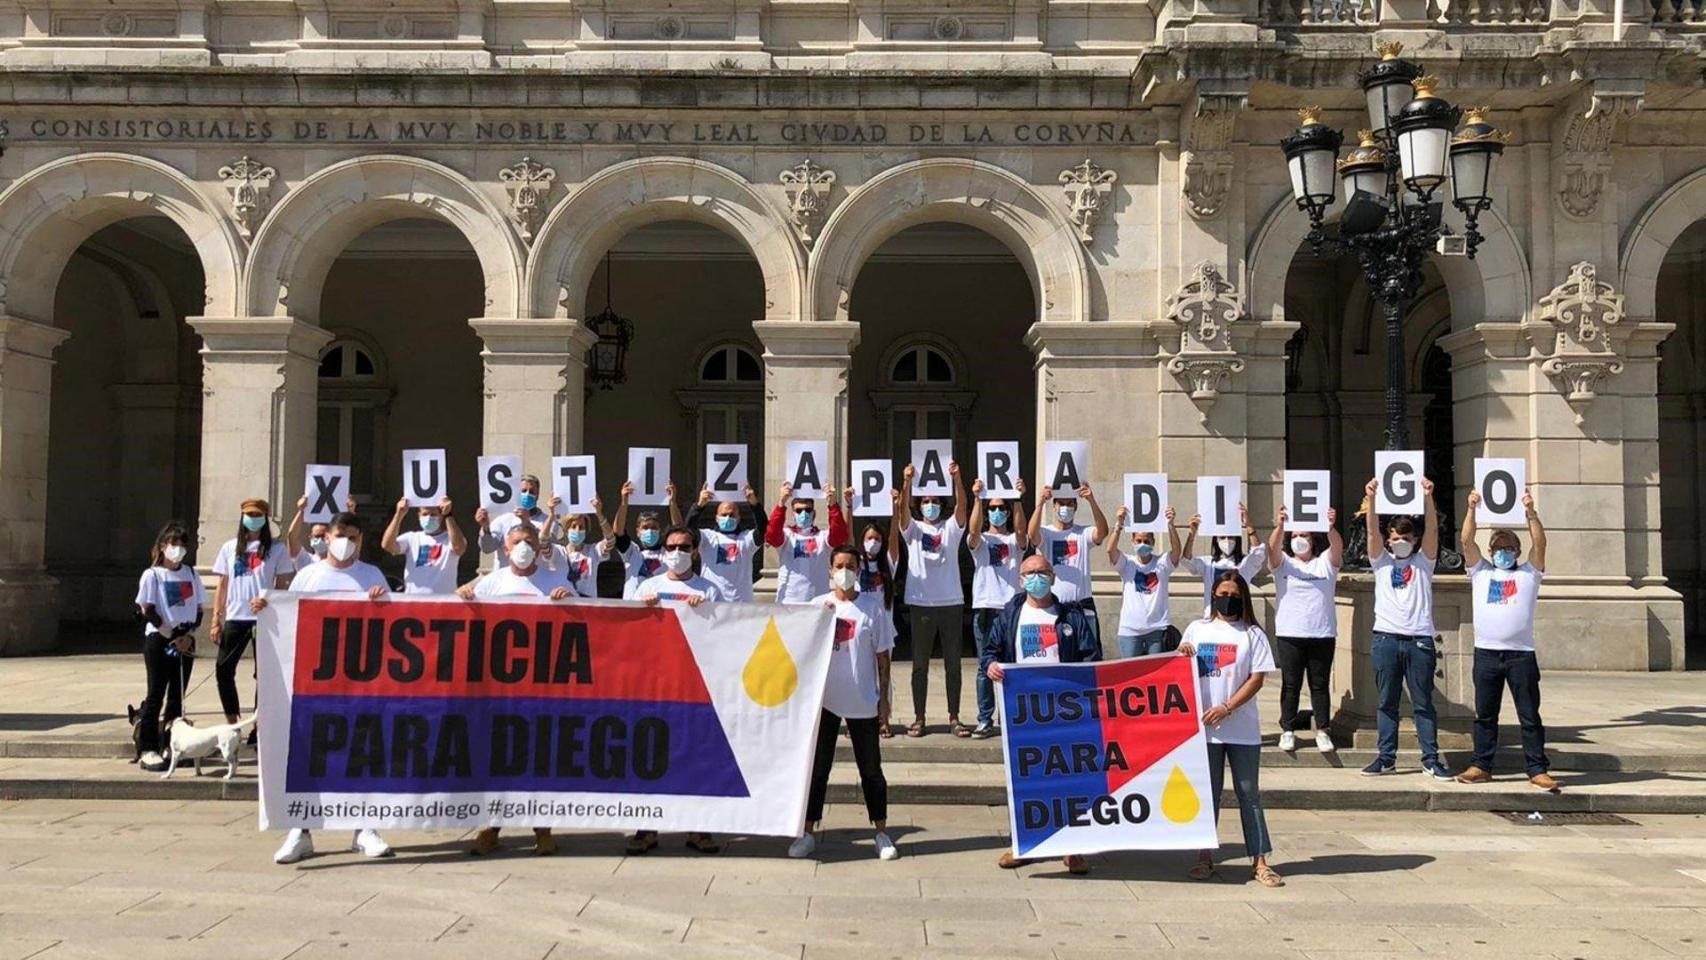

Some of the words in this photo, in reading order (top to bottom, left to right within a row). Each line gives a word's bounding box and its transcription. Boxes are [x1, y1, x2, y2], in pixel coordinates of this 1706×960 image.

[31, 119, 272, 139] CONSISTORIALES
[294, 122, 328, 139] DE
[347, 122, 379, 140] LA
[400, 121, 456, 140] MVY
[475, 122, 567, 140] NOBLE
[582, 123, 599, 140] Y
[617, 123, 675, 140] MVY
[694, 123, 760, 142] LEAL
[910, 125, 942, 142] DE
[963, 125, 994, 143] LA
[1015, 122, 1137, 143] CORVÑA
[412, 460, 439, 498] U
[487, 464, 513, 504] S
[560, 466, 587, 505] T
[645, 456, 654, 495] I
[713, 453, 740, 491] Z
[793, 451, 821, 490] A
[918, 449, 946, 487] A
[986, 452, 1013, 490] R
[1052, 452, 1081, 490] A
[1383, 462, 1417, 505] G
[311, 475, 342, 514] X
[861, 470, 884, 507] P
[1132, 484, 1160, 523] D
[1215, 485, 1225, 525] I
[1293, 481, 1318, 522] E
[1482, 470, 1517, 514] O
[312, 616, 593, 685] JUSTICIA
[1013, 684, 1189, 724] JUSTICIA
[308, 712, 472, 779] PARA
[489, 714, 670, 780] DIEGO
[1018, 741, 1129, 777] PARA
[287, 801, 481, 819] #justiciaparadiego
[487, 800, 664, 819] #galiciatereclama
[1023, 793, 1151, 830] DIEGO
